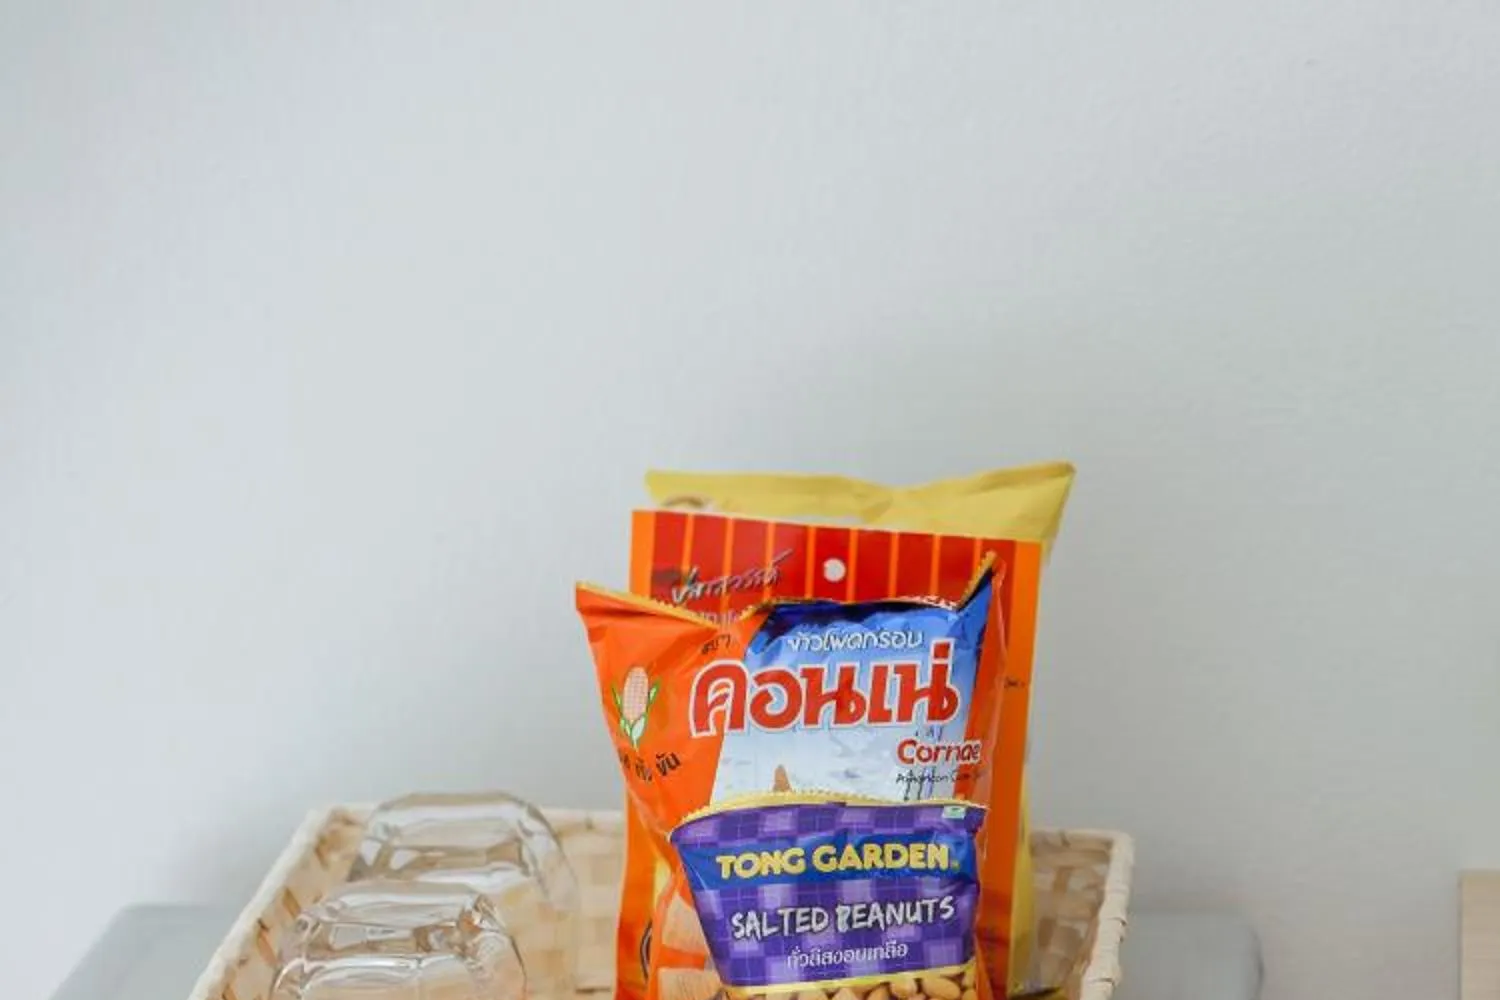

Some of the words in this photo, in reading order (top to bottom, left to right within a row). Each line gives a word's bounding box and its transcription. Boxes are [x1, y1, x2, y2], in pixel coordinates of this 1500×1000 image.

[690, 638, 960, 738] คอนเน่
[716, 847, 806, 880] TONG
[811, 843, 949, 873] GARDEN
[731, 907, 829, 941] SALTED
[835, 896, 955, 933] PEANUTS
